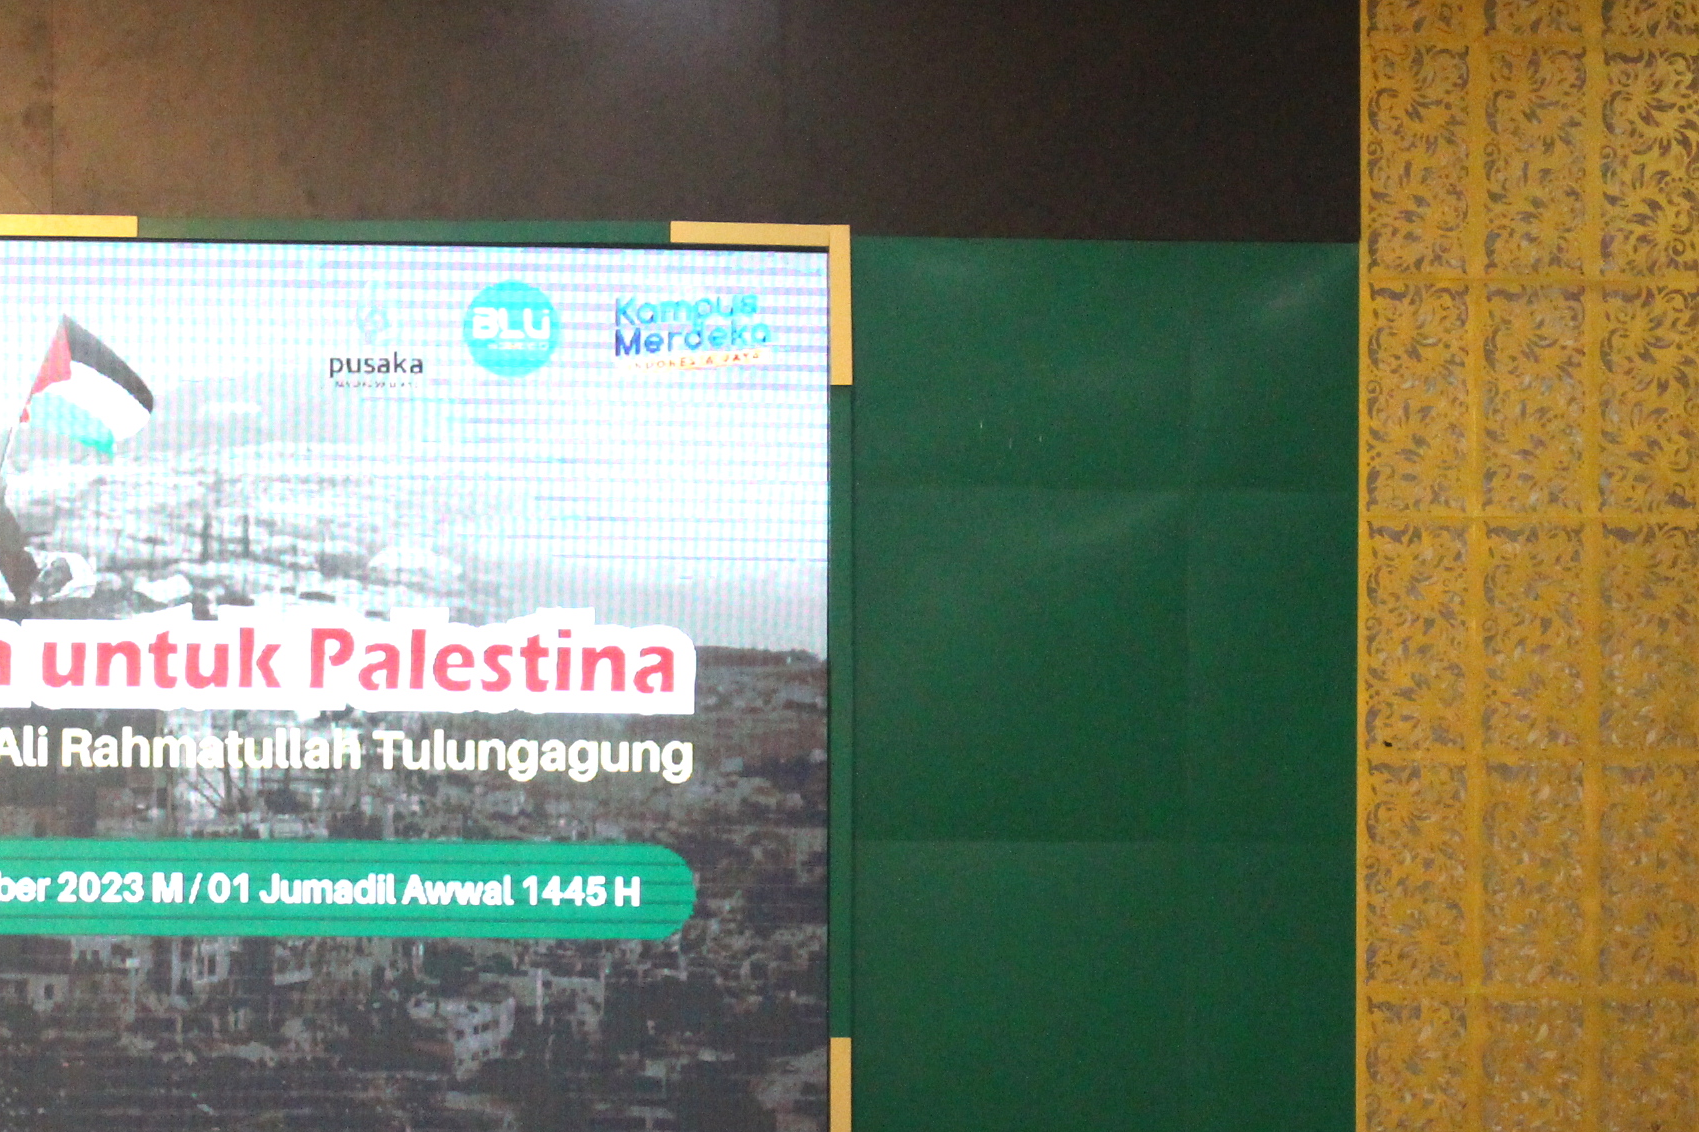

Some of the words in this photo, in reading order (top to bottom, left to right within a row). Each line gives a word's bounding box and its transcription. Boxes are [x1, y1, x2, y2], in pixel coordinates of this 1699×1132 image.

[472, 307, 551, 340] BLU
[615, 318, 771, 357] Merdeka
[328, 351, 424, 378] pusaka
[41, 627, 282, 690] untuk
[309, 628, 675, 694] Palestina
[61, 727, 361, 770] Rahmatullah
[373, 730, 694, 784] Tulungagung
[57, 871, 145, 903] 2023
[151, 872, 184, 904] M
[207, 872, 249, 904] 01
[259, 873, 397, 905] Jumadil
[402, 874, 515, 906] Awwal
[522, 875, 607, 907] 1445
[614, 876, 641, 907] H
